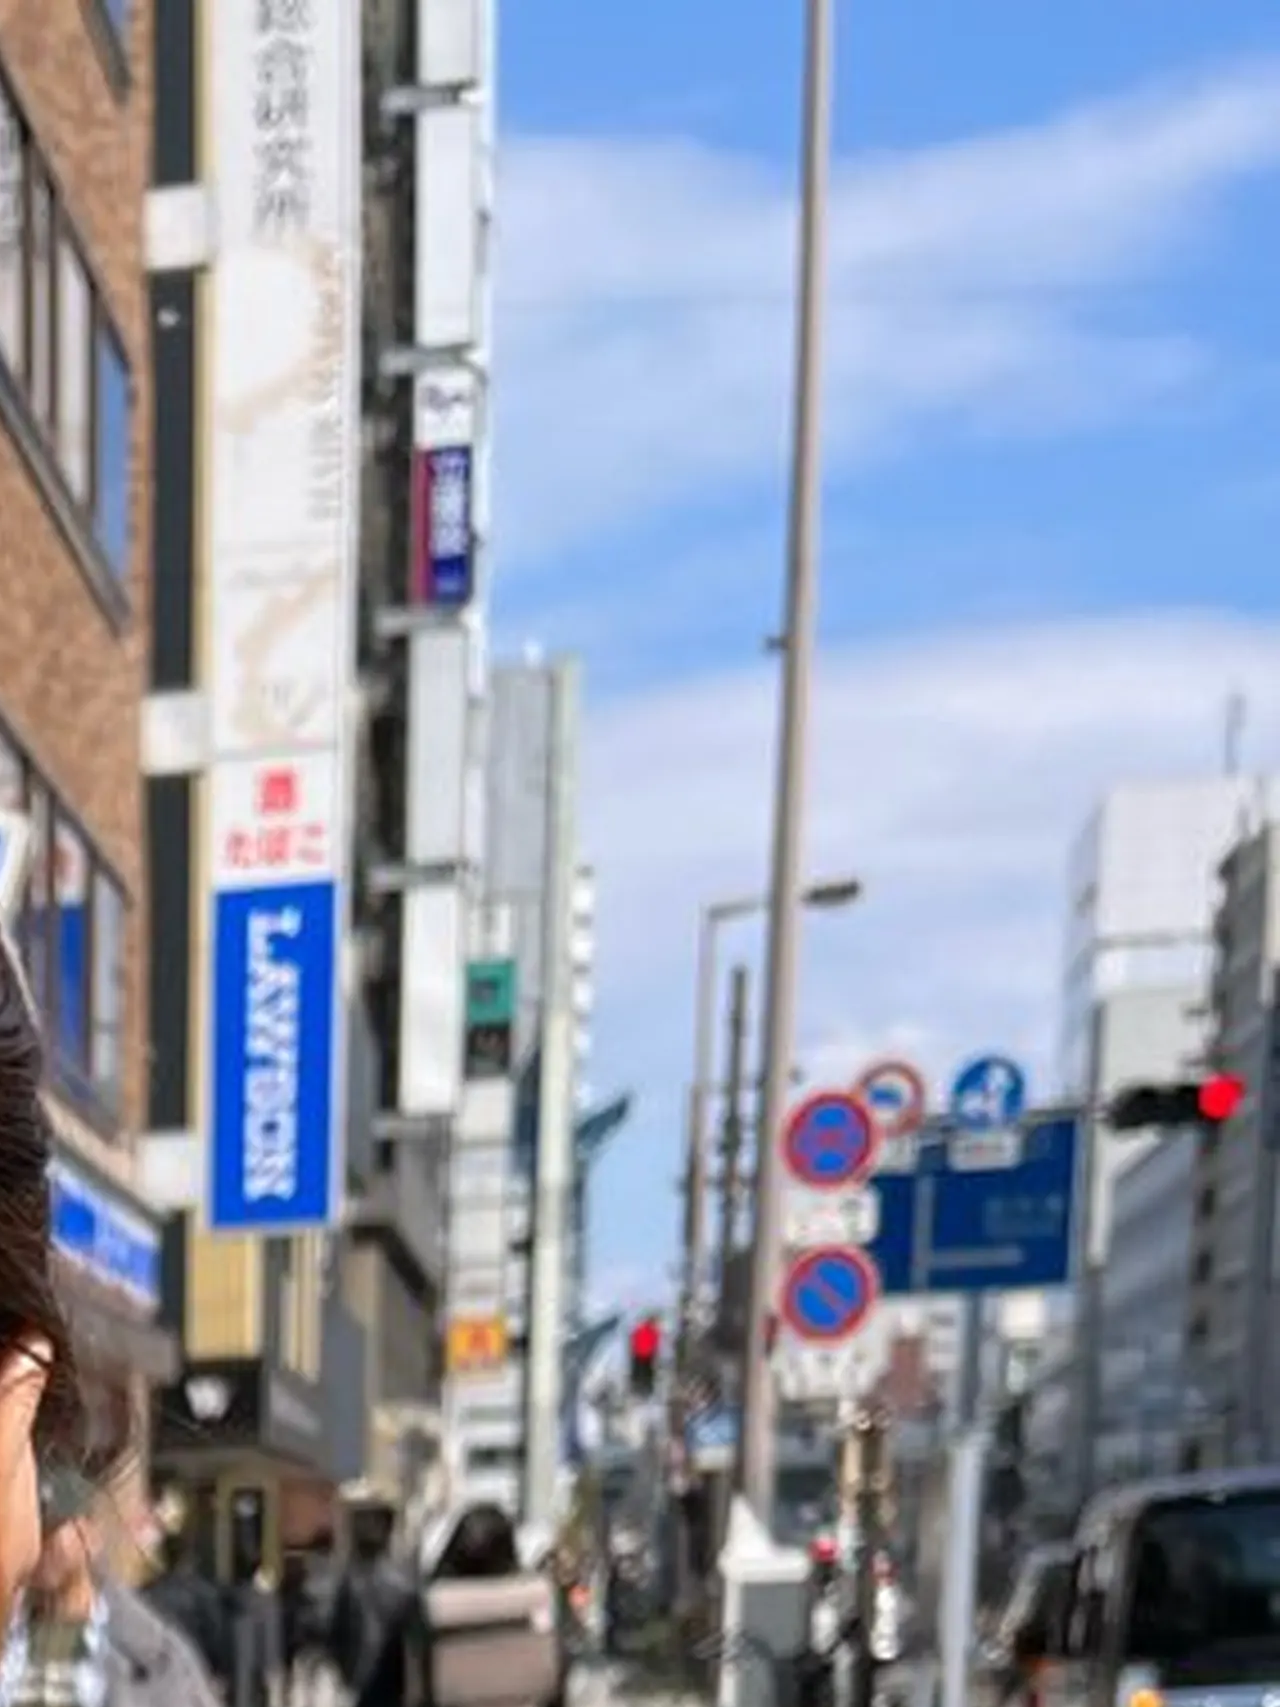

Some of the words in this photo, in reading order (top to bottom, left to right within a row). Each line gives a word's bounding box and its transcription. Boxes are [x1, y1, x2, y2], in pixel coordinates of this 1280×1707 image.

[224, 822, 326, 867] たばこ
[243, 903, 302, 1201] LAWSON
